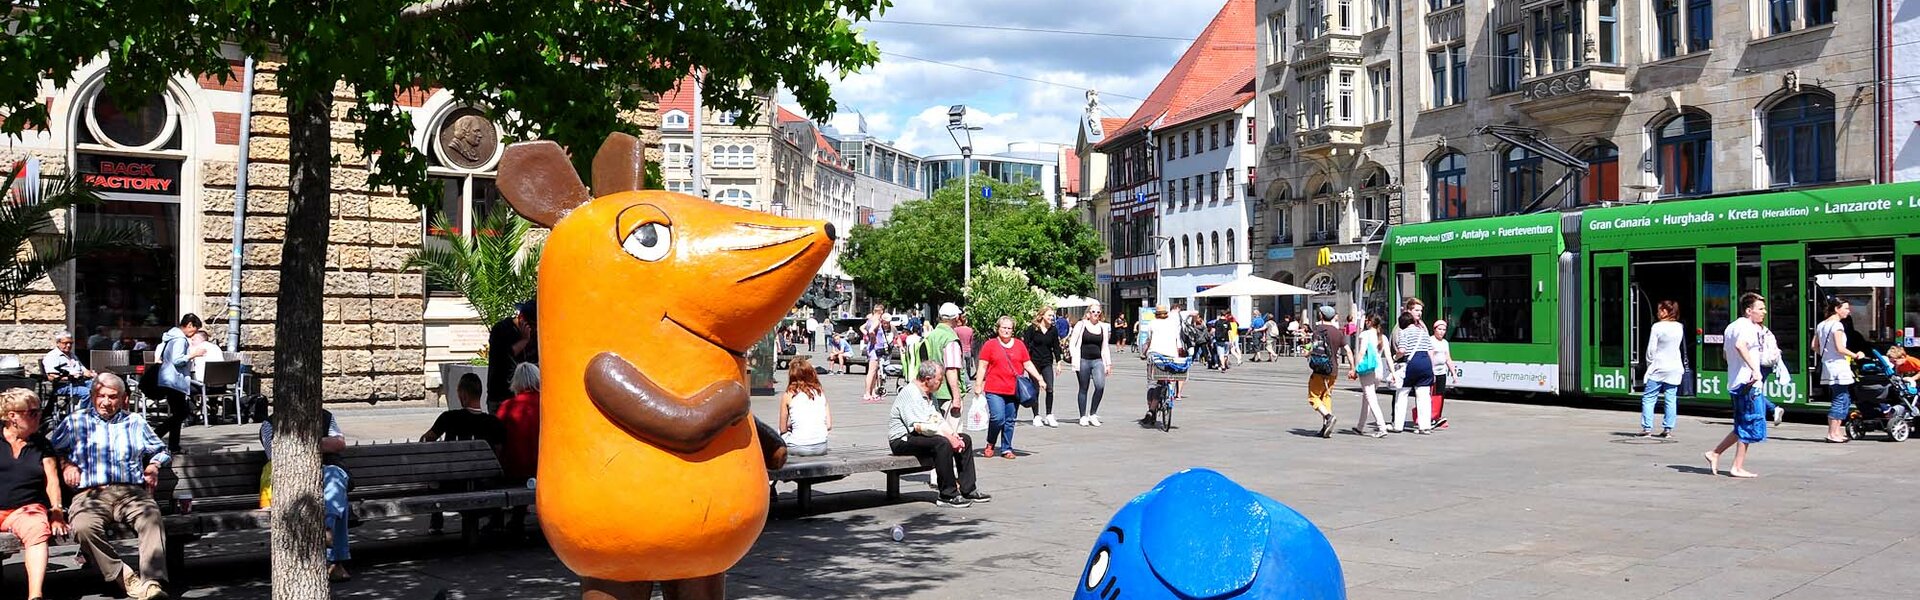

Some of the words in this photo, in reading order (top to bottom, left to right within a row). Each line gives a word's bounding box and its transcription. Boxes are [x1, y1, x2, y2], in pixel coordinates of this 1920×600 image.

[100, 161, 155, 176] BACK
[83, 174, 172, 190] FACTORY
[1589, 219, 1611, 230] Gran
[1614, 216, 1650, 229] Canaria
[1663, 211, 1714, 227] Hurghada
[1728, 208, 1759, 220] Kreta
[1762, 206, 1809, 219] (Heraklion)
[1825, 199, 1891, 214] Lanzarote
[1395, 235, 1418, 246] Zypern
[1461, 227, 1489, 240] Antalya
[1498, 224, 1553, 237] Fuerteventura
[1593, 369, 1626, 390] nah
[1697, 373, 1721, 395] ist
